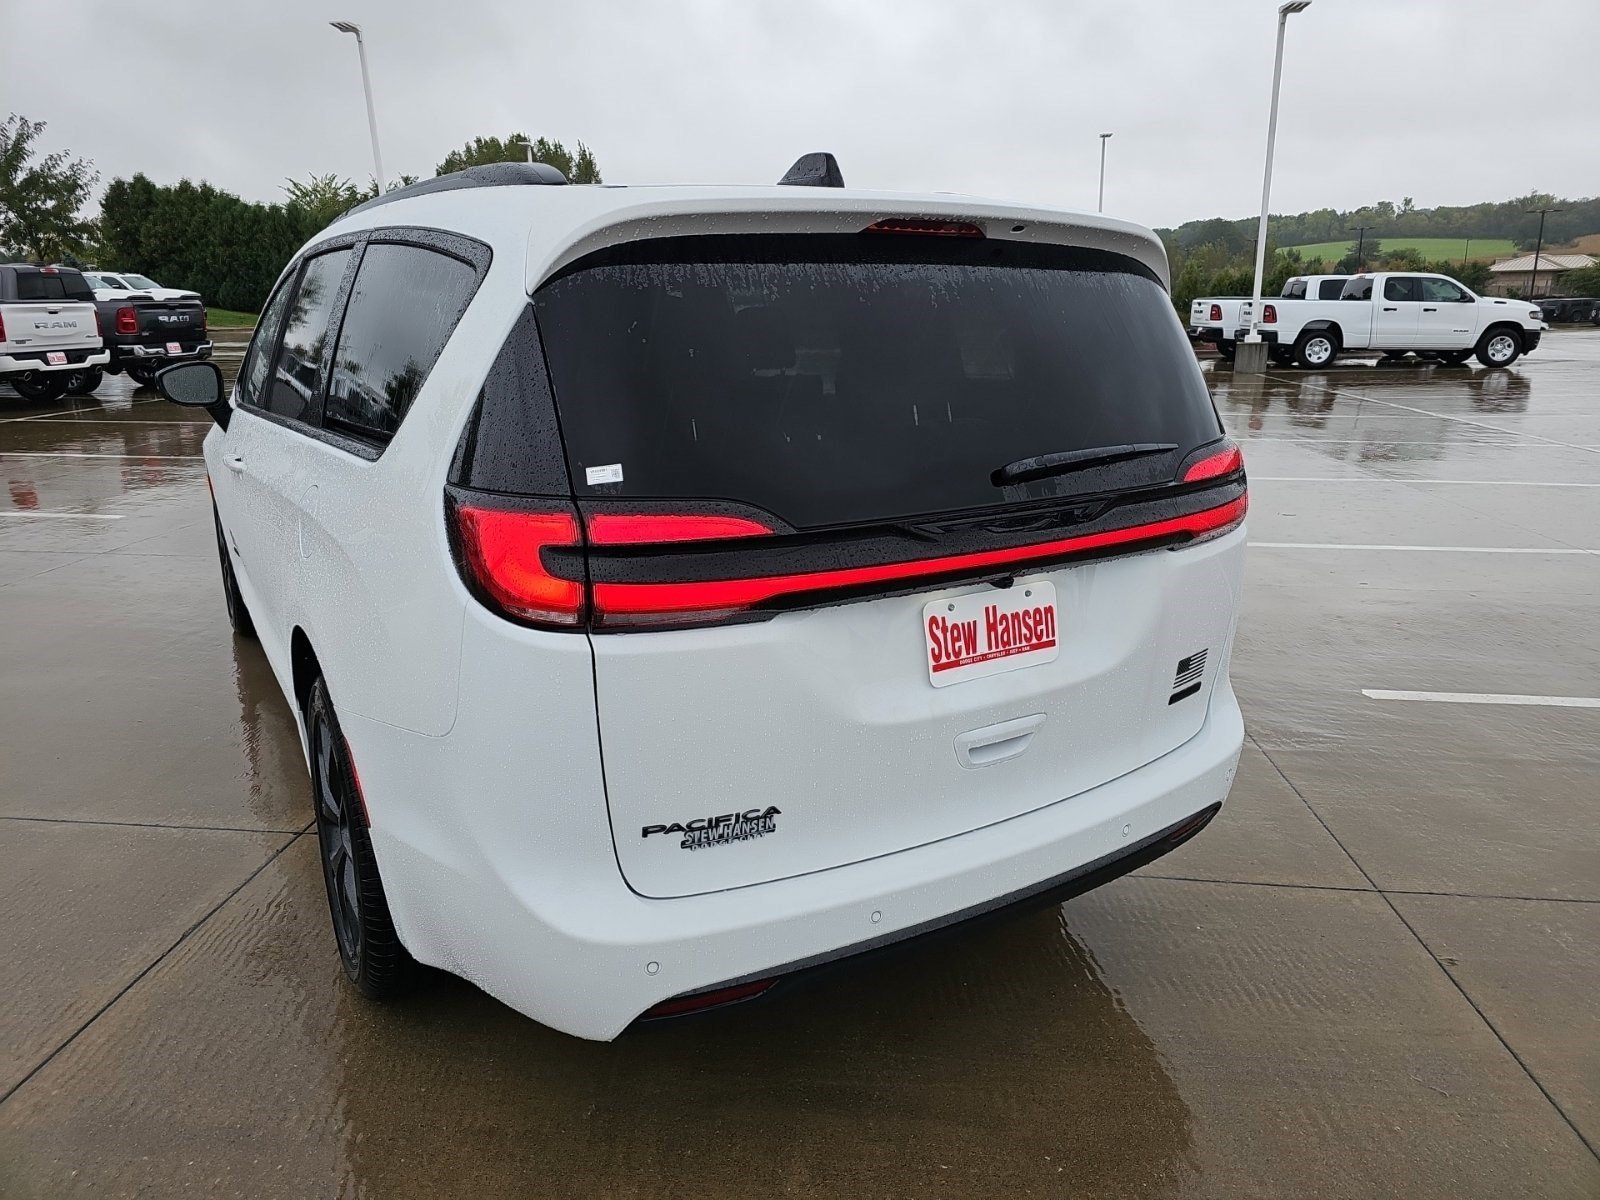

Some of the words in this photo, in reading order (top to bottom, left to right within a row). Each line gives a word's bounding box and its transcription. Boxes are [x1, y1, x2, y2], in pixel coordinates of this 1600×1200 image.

[33, 321, 77, 329] RAM
[928, 615, 977, 662] Stew
[985, 604, 1056, 651] Hansen
[641, 805, 782, 838] PACIFICA
[685, 827, 720, 844] STEW
[723, 815, 775, 838] HANSEN
[691, 839, 733, 851] DODGE
